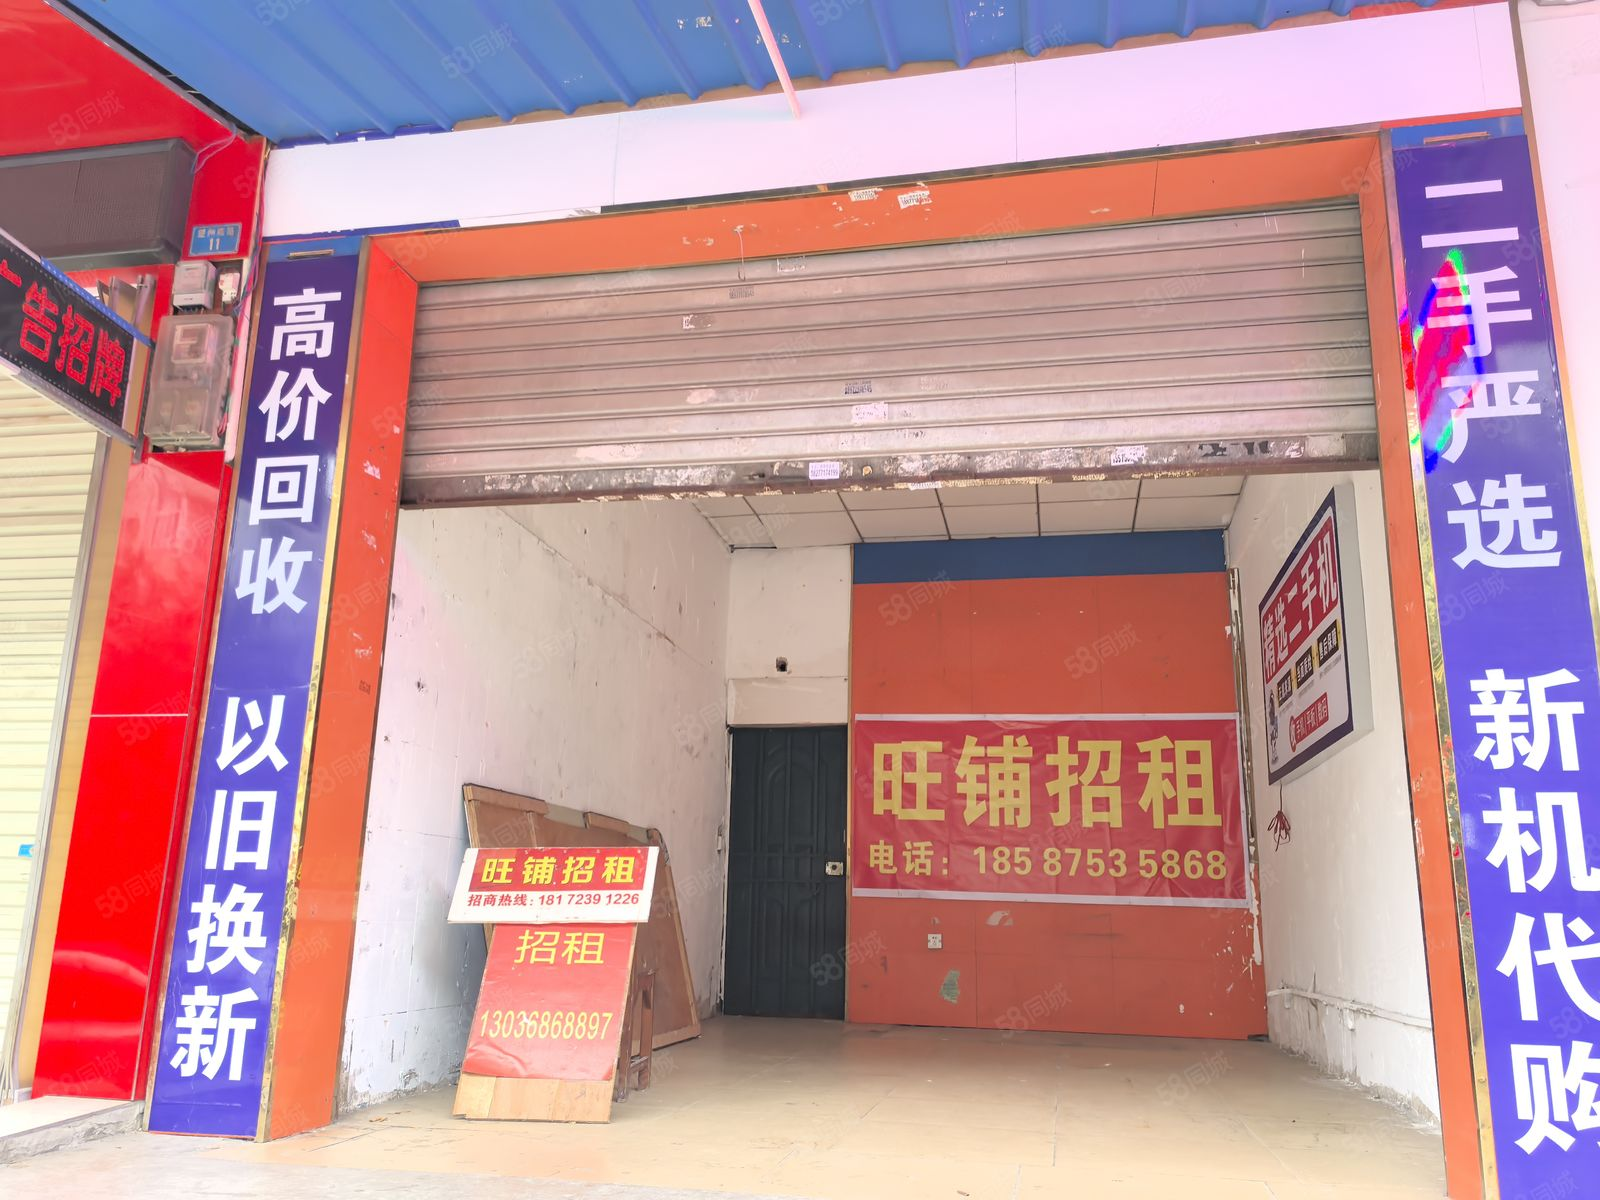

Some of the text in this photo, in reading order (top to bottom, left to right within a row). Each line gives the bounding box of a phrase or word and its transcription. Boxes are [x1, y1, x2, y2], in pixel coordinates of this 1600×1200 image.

[209, 238, 220, 250] 11
[1421, 180, 1562, 569] 二手严选
[235, 288, 342, 614] 高价回收
[1263, 531, 1337, 680] 精选二手机
[873, 734, 1222, 829] 旺铺招租
[170, 694, 289, 1081] 以旧换新
[481, 856, 636, 885] 旺铺招租
[973, 846, 1032, 875] 185
[1043, 847, 1127, 878] 8753
[1138, 849, 1227, 880] 5868
[514, 929, 604, 965] 招租
[1469, 668, 1600, 1154] 新机代购
[480, 1009, 613, 1040] 13036868897
